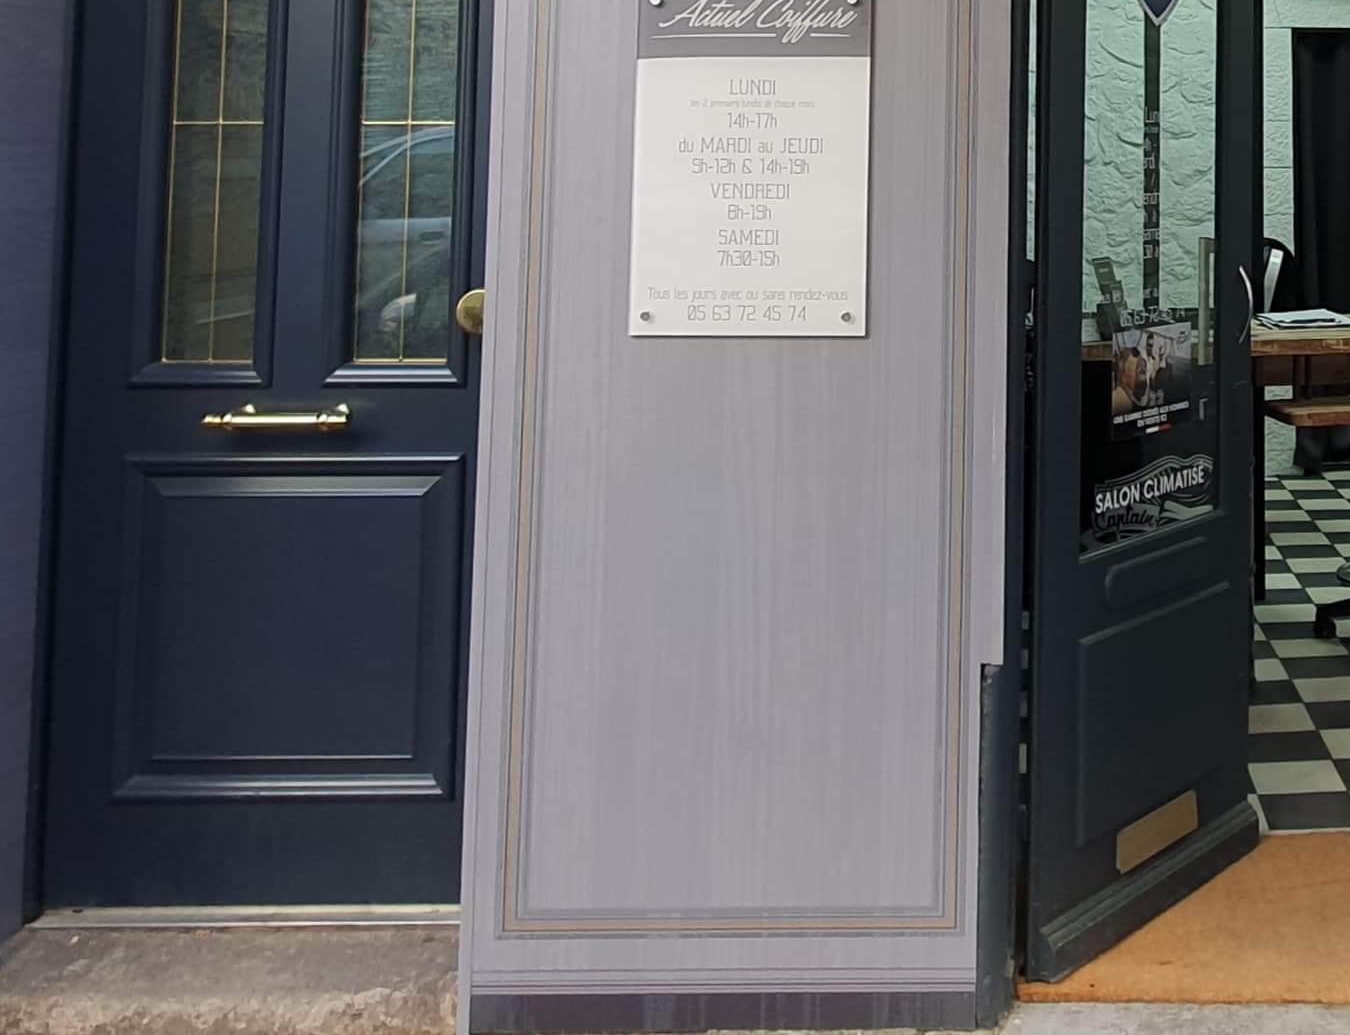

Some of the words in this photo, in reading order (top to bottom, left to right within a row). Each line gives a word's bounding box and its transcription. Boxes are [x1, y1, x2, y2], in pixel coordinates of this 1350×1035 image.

[729, 79, 776, 96] LUNDI
[728, 112, 778, 129] 14h-17h
[679, 138, 694, 153] du
[700, 137, 752, 153] MARDI
[758, 141, 773, 153] au
[780, 137, 824, 154] JEUDI
[711, 183, 790, 200] VENDREDI
[718, 229, 779, 246] SAMEDI
[648, 287, 670, 300] Tous
[674, 287, 688, 300] les
[690, 288, 716, 302] jours
[720, 290, 742, 300] avec
[746, 290, 758, 300] ou
[762, 290, 785, 300] sans
[789, 288, 848, 301] rendez-vous
[687, 305, 706, 321] 05
[712, 305, 731, 321] 63
[738, 305, 756, 321] 72
[763, 305, 782, 322] 45
[788, 305, 807, 322] 74
[1096, 483, 1140, 514] SALON
[1143, 465, 1205, 499] CLIMATISE
